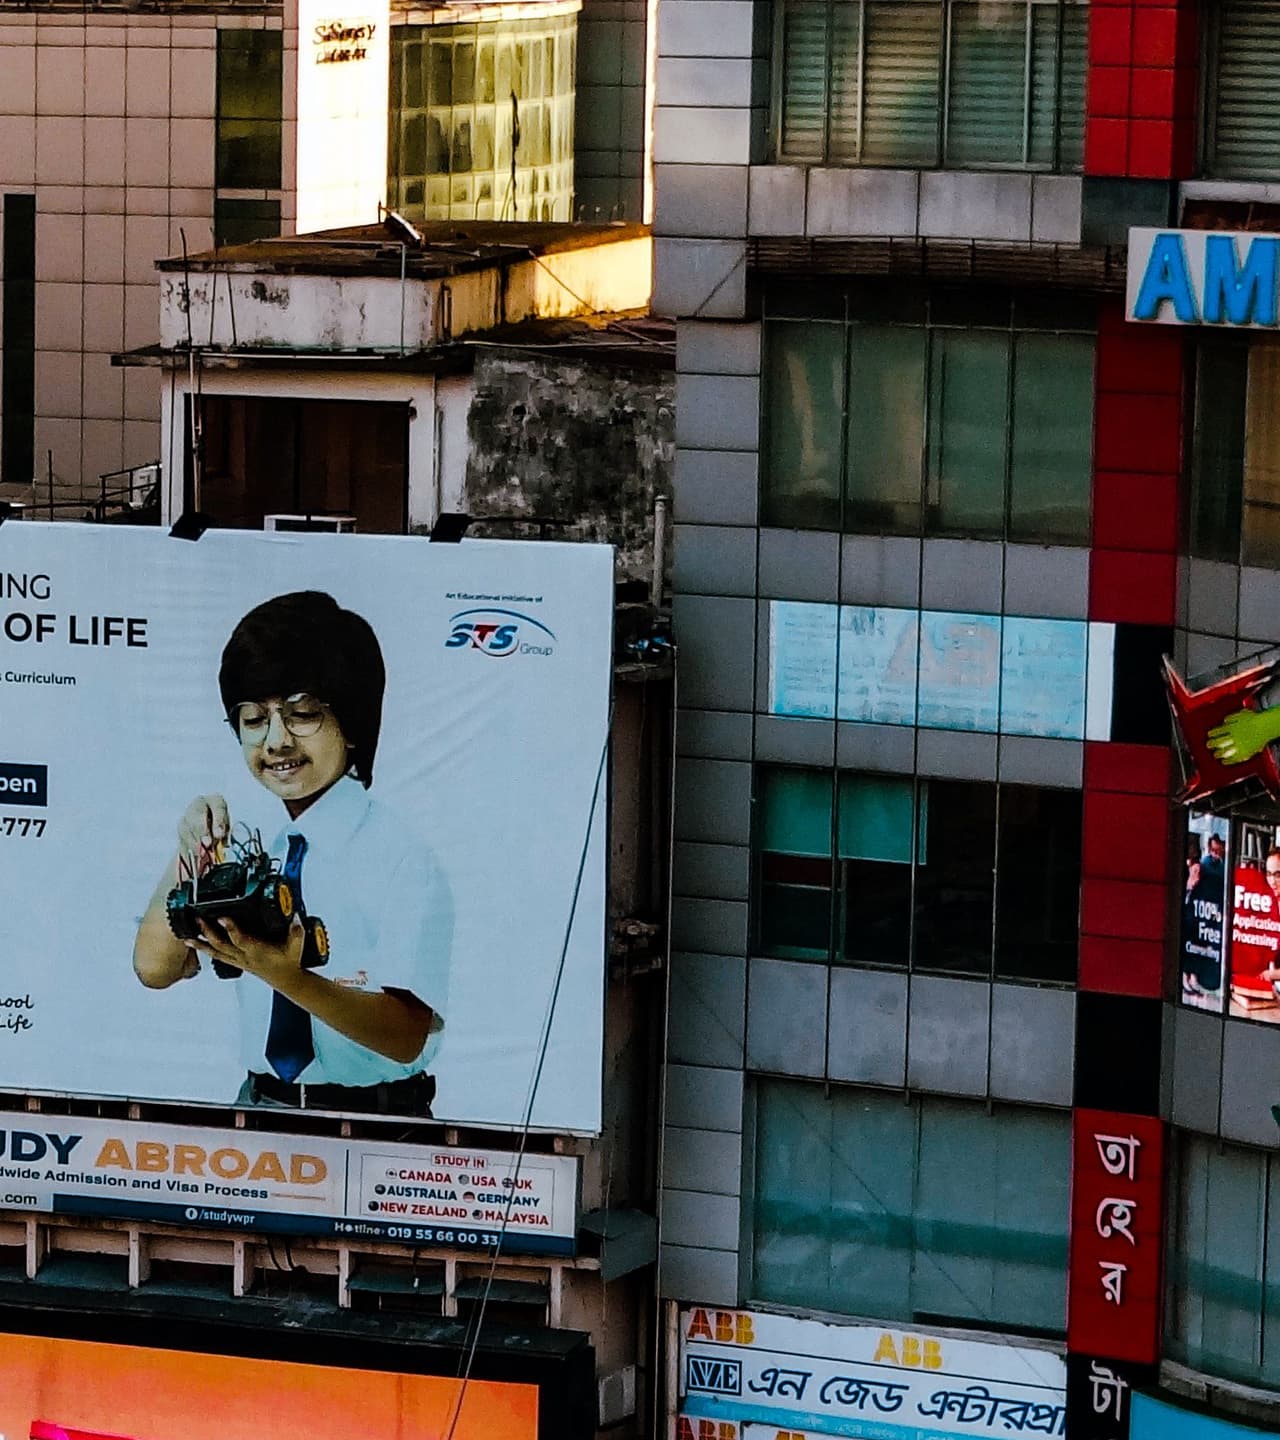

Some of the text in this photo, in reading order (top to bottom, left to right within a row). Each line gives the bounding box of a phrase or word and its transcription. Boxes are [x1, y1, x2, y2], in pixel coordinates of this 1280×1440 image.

[4, 612, 56, 643] OF
[68, 615, 148, 648] LIFE
[445, 623, 519, 650] STS
[520, 643, 553, 656] Group
[5, 671, 77, 686] Curriculum
[1234, 884, 1273, 913] Free
[1193, 899, 1222, 923] 100%
[1198, 922, 1221, 944] Free
[1232, 928, 1278, 950] Processing
[94, 1138, 329, 1186] ABROAD
[434, 1154, 485, 1169] STUDY IN
[44, 1169, 127, 1187] Admission
[132, 1177, 162, 1191] and
[166, 1179, 199, 1194] Visa
[204, 1183, 269, 1199] Process
[399, 1169, 533, 1190] CANADA USA UK
[387, 1186, 541, 1207] AUSTRALIA GERMANY
[380, 1202, 550, 1226] NEW ZEALAND MALAYSIA
[387, 1226, 412, 1239] 019
[415, 1228, 433, 1241] 55
[458, 1232, 478, 1244] 00
[481, 1234, 499, 1247] 33
[687, 1308, 756, 1345] ABB
[872, 1332, 944, 1370] ABB
[747, 1367, 814, 1401] এন
[819, 1376, 910, 1413] জেড
